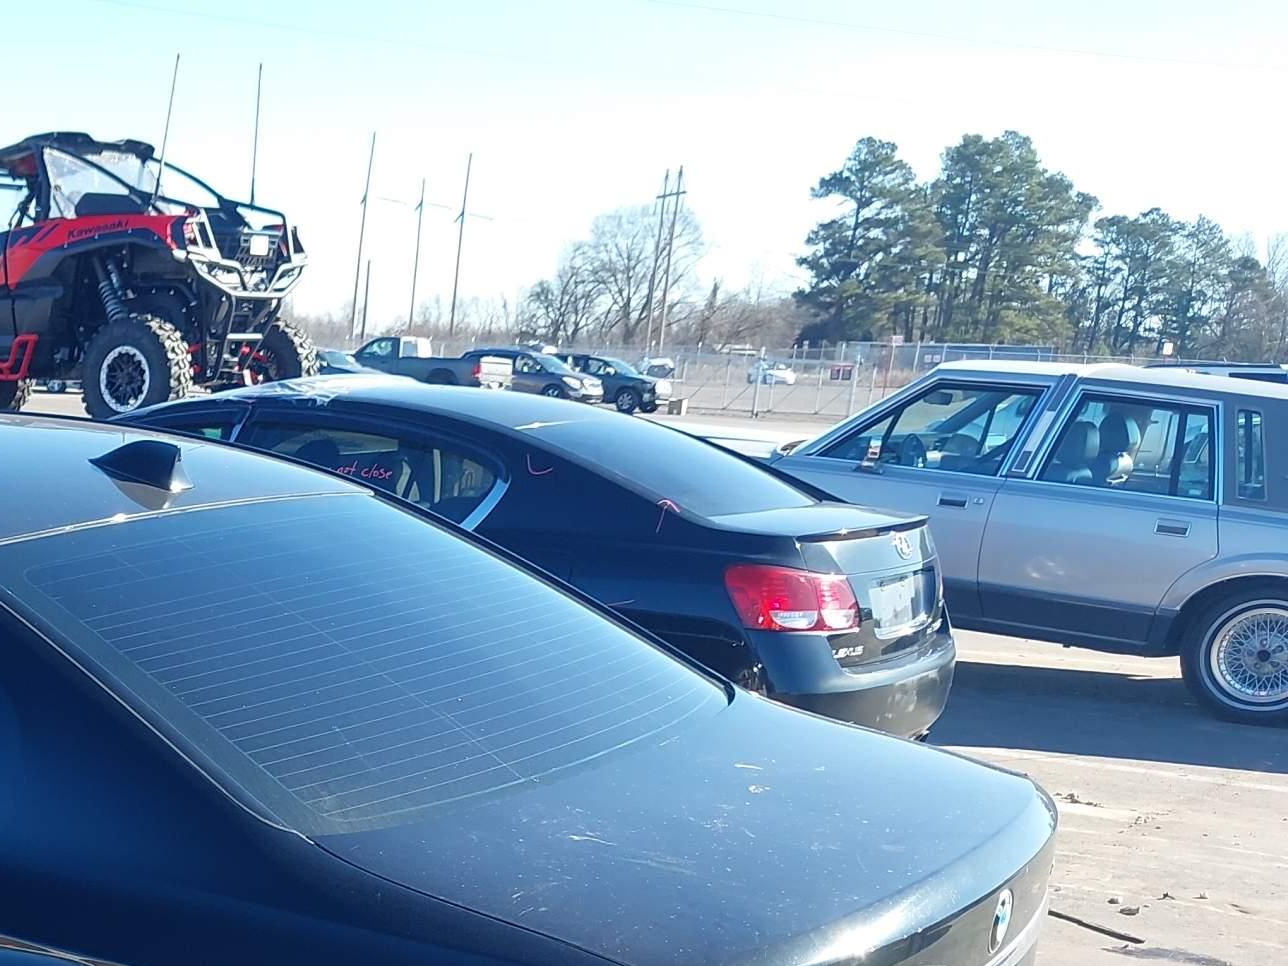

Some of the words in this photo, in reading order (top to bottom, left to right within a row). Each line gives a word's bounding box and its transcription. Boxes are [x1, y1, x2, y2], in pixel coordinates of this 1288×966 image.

[67, 219, 130, 239] Kawasaki
[361, 463, 393, 479] close
[832, 645, 864, 659] LEXUS
